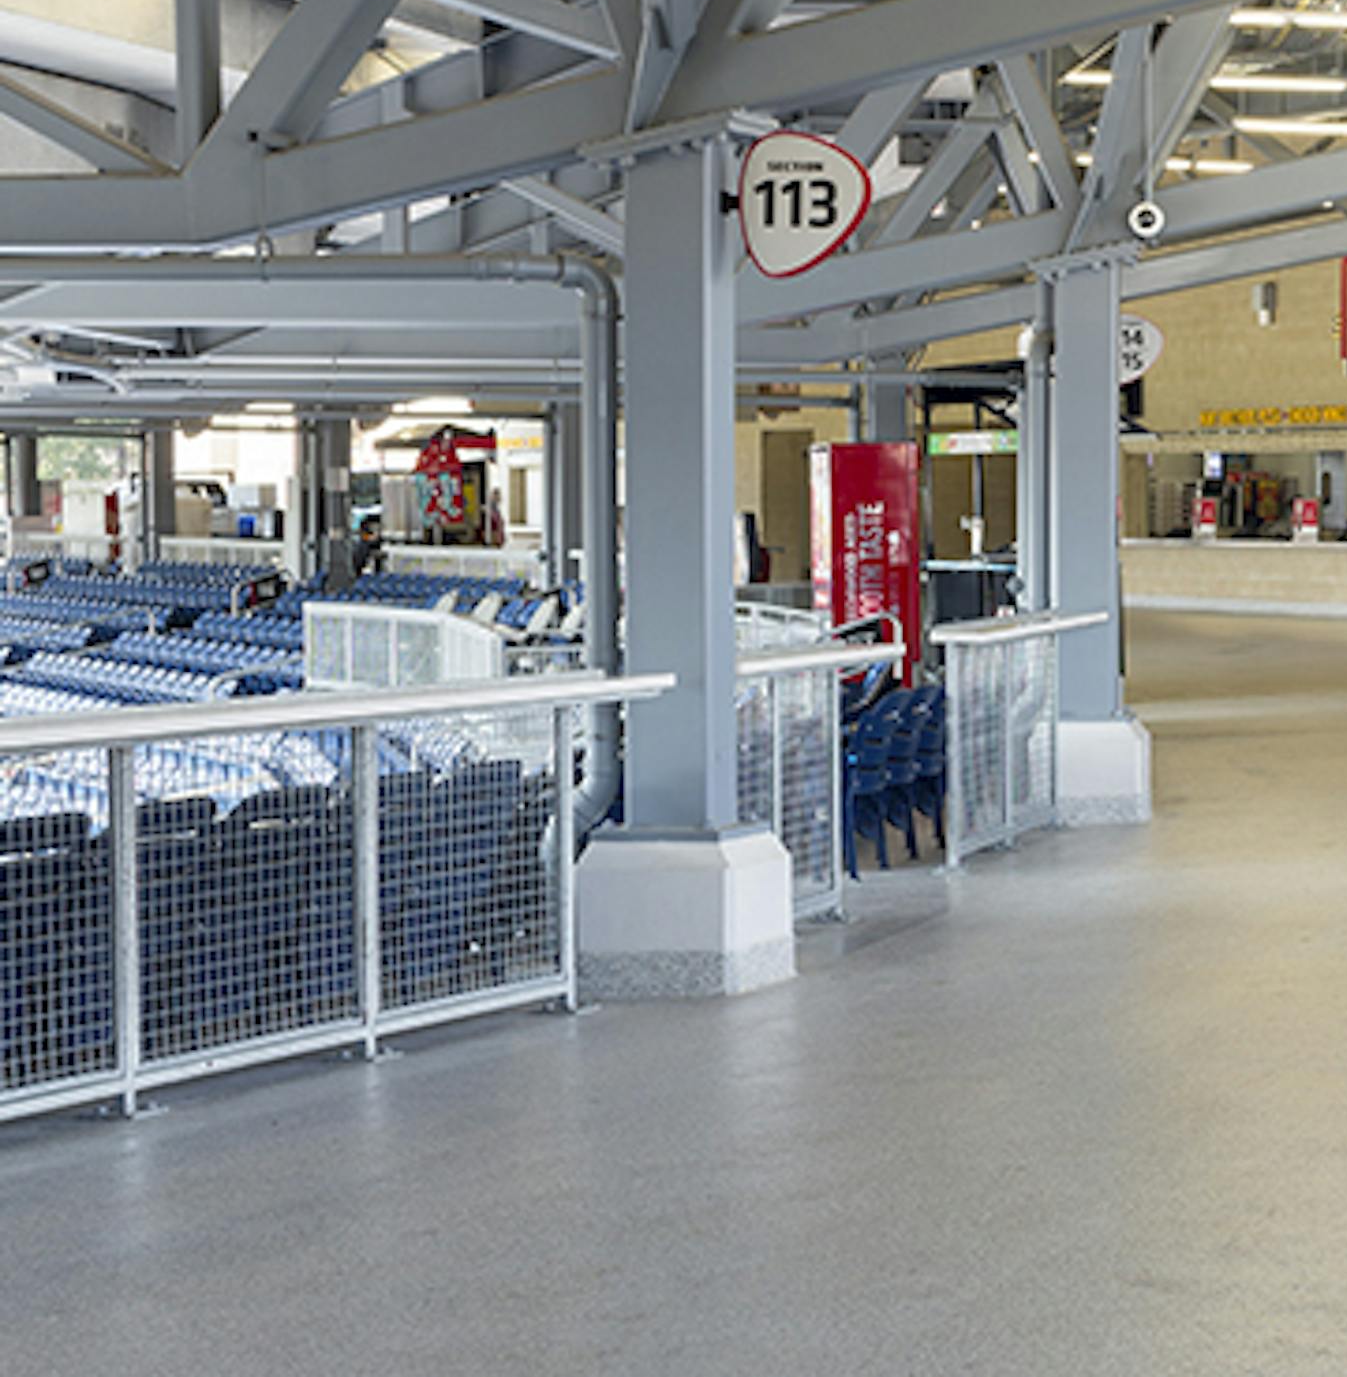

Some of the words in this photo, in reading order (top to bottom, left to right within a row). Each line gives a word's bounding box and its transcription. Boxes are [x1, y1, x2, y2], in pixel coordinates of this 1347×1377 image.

[767, 161, 823, 171] SECTION
[754, 180, 837, 227] 113
[1121, 329, 1144, 346] 14
[1121, 351, 1144, 370] 15
[858, 500, 885, 560] TASTE
